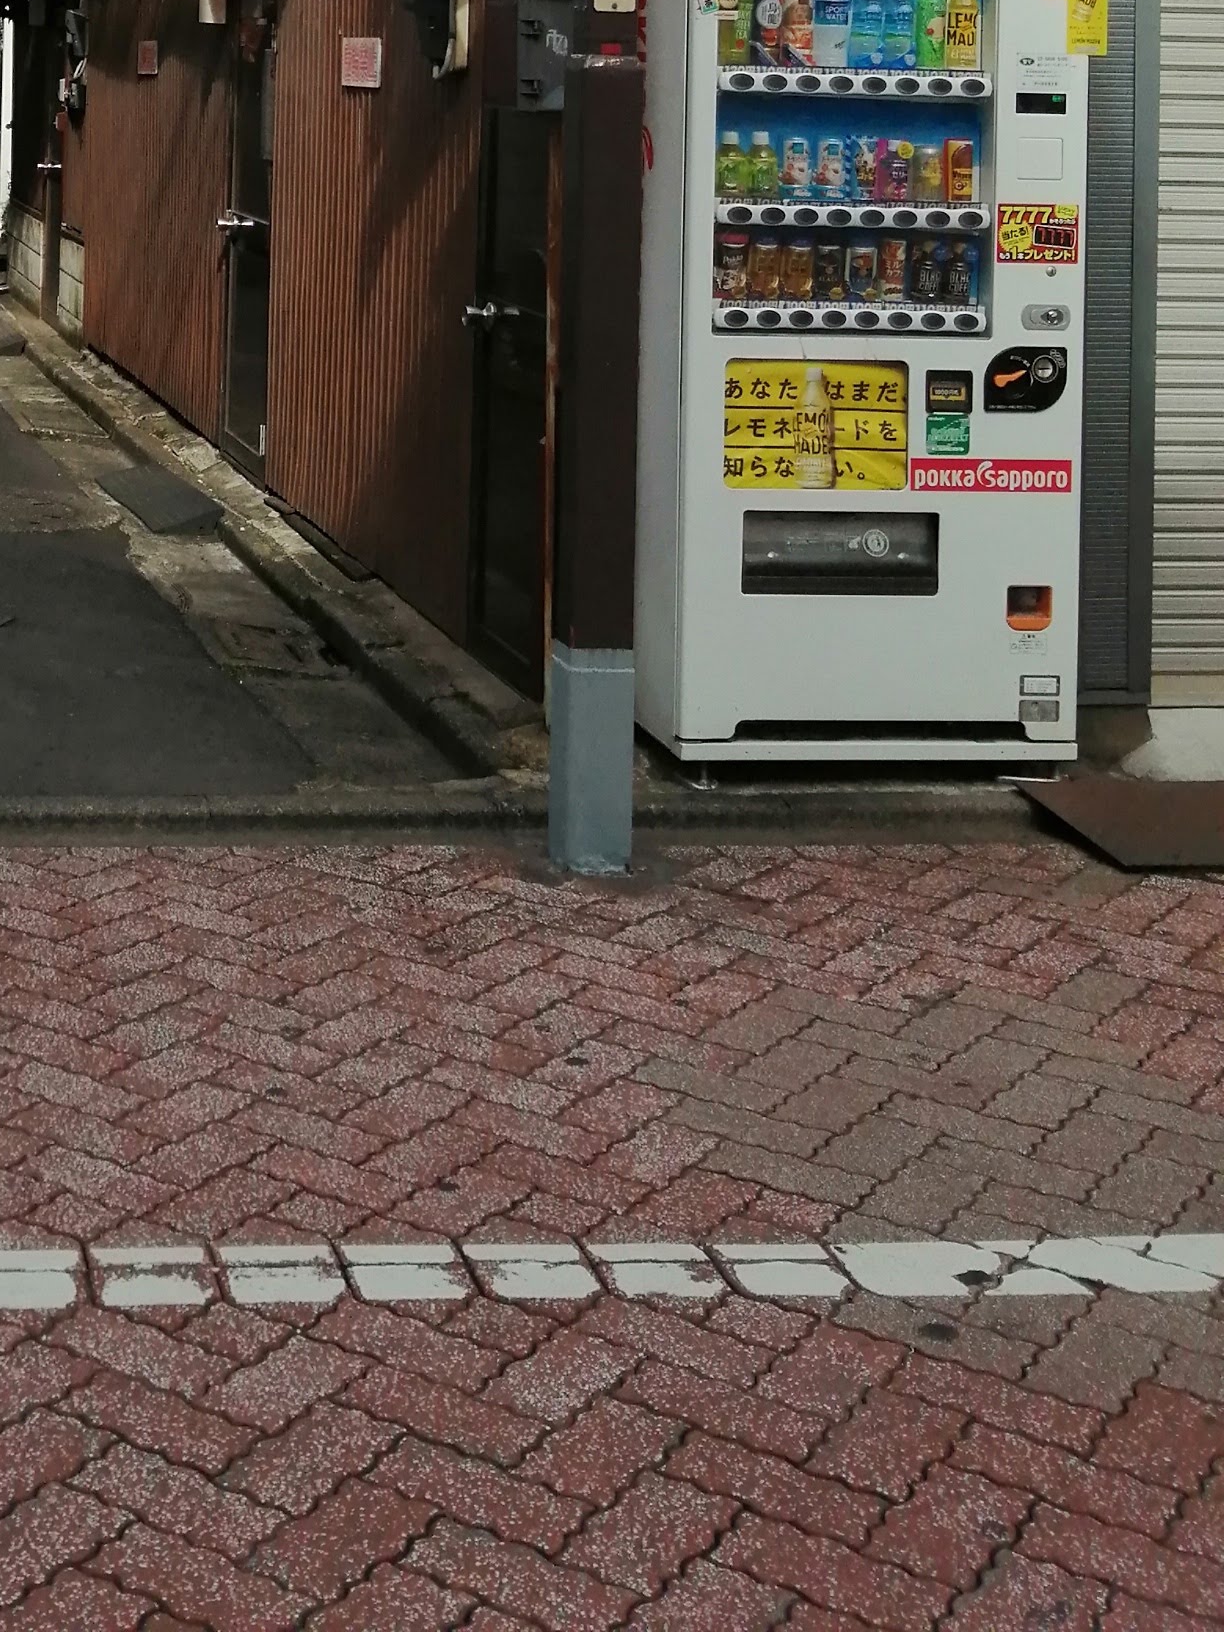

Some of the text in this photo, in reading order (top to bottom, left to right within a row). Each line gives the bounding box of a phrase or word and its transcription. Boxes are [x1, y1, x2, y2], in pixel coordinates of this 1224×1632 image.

[1000, 206, 1052, 224] 7777
[725, 377, 798, 400] あなた
[724, 455, 794, 478] 知らな
